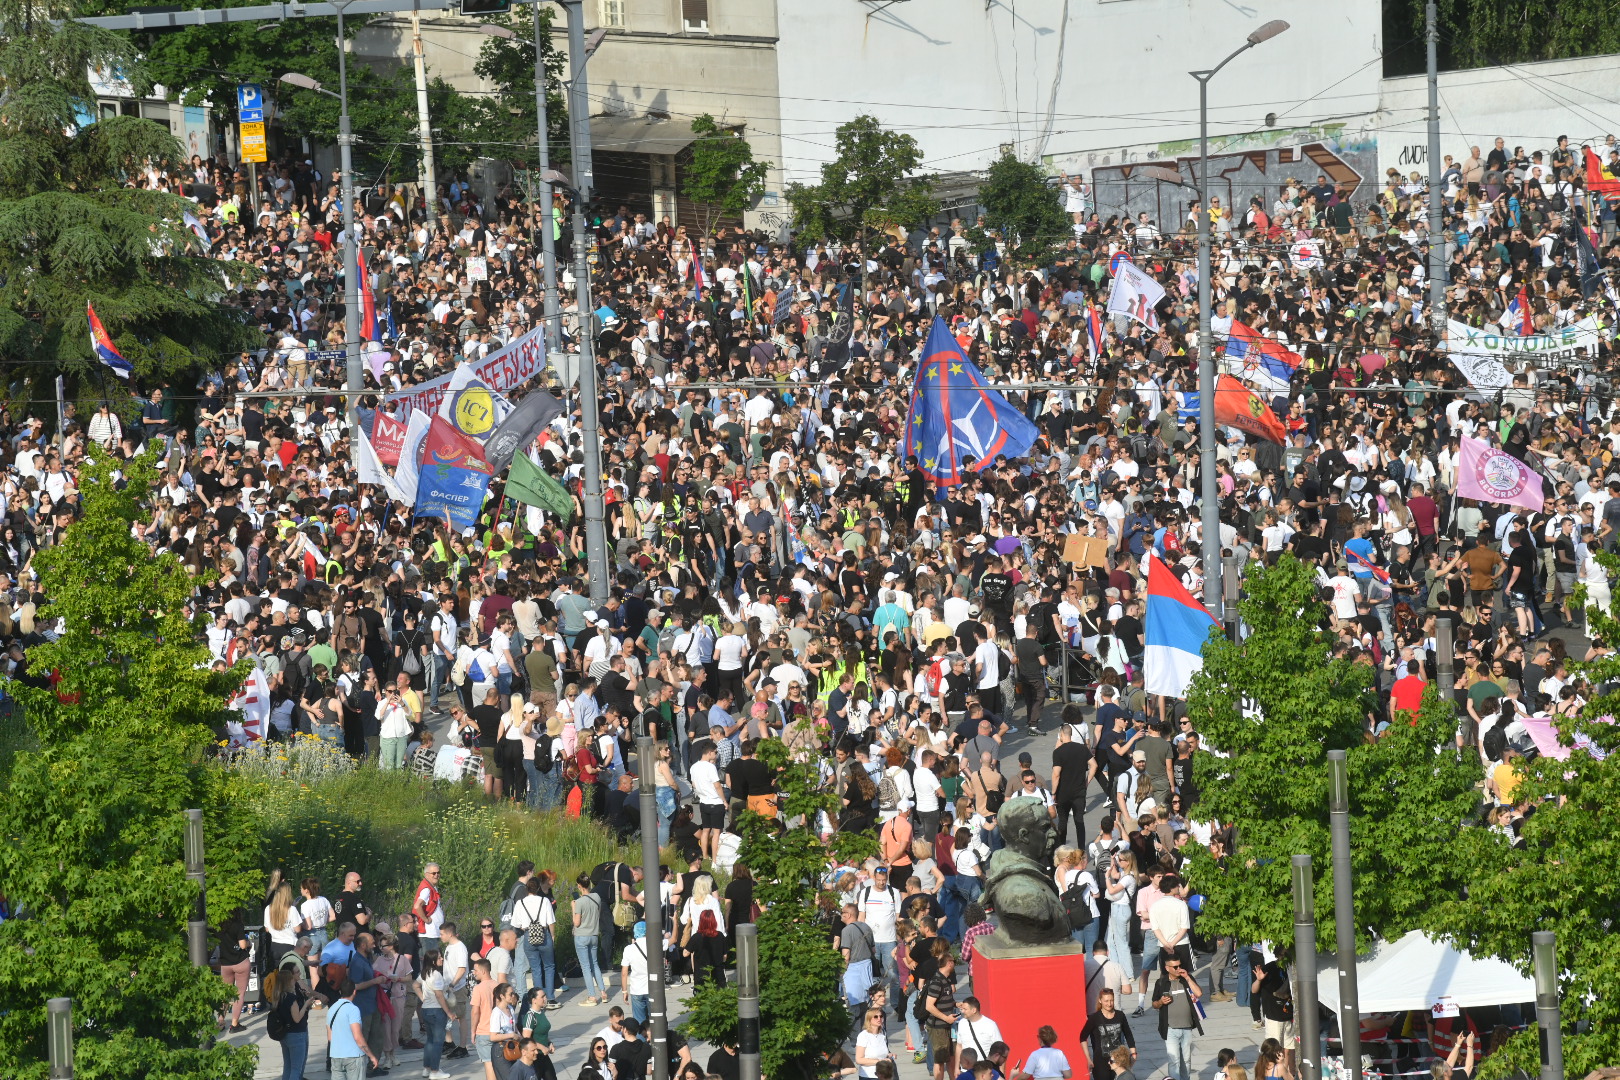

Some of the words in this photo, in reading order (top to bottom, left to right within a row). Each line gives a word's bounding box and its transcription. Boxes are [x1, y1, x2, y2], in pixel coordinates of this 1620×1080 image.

[243, 87, 256, 106] P
[431, 490, 469, 502] ФАСПЕР
[1478, 479, 1522, 498] BEOGRADA
